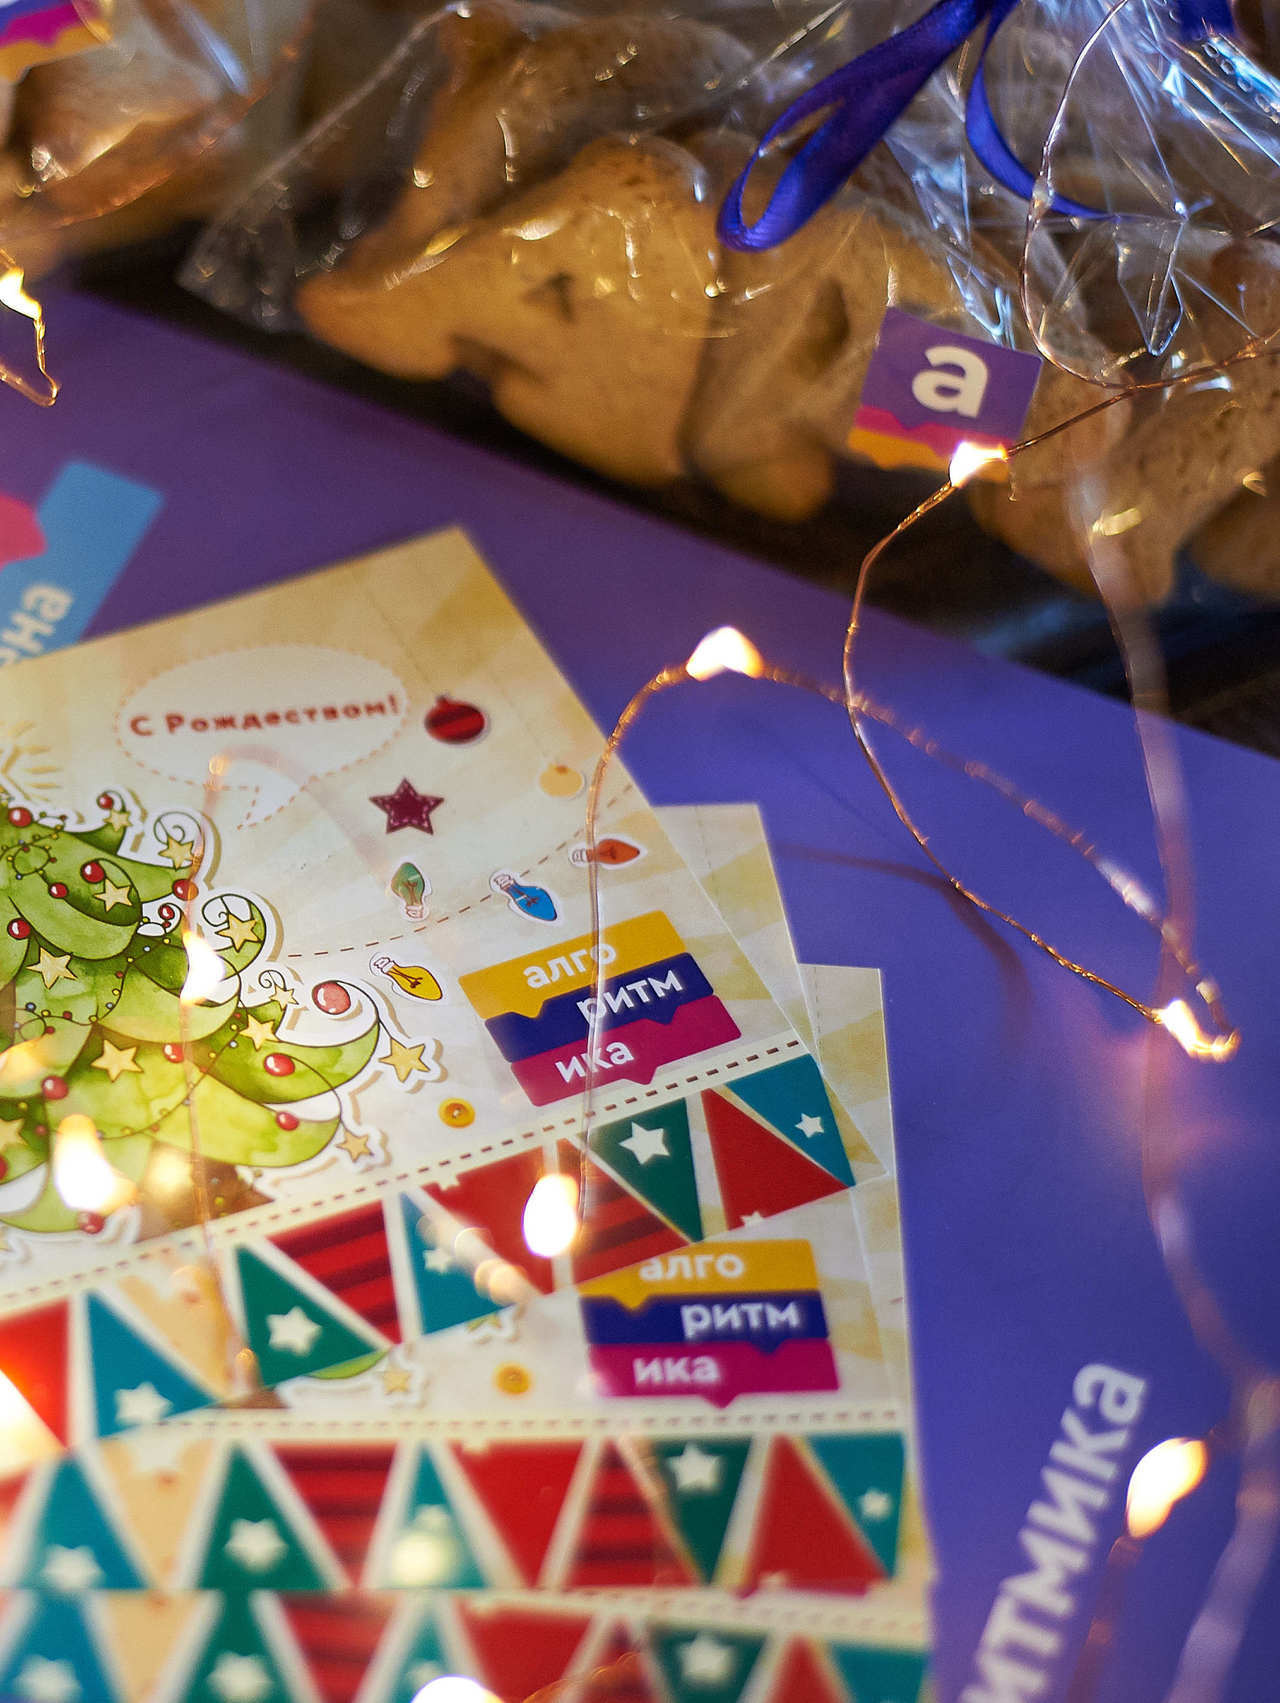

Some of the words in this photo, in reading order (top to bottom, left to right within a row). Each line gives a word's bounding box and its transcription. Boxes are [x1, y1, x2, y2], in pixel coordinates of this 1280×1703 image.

[523, 942, 617, 989] алго
[576, 969, 684, 1025] ритм
[554, 1040, 634, 1084] ика
[638, 1253, 747, 1281] алго
[680, 1301, 802, 1340] ритм
[631, 1354, 721, 1386] ика
